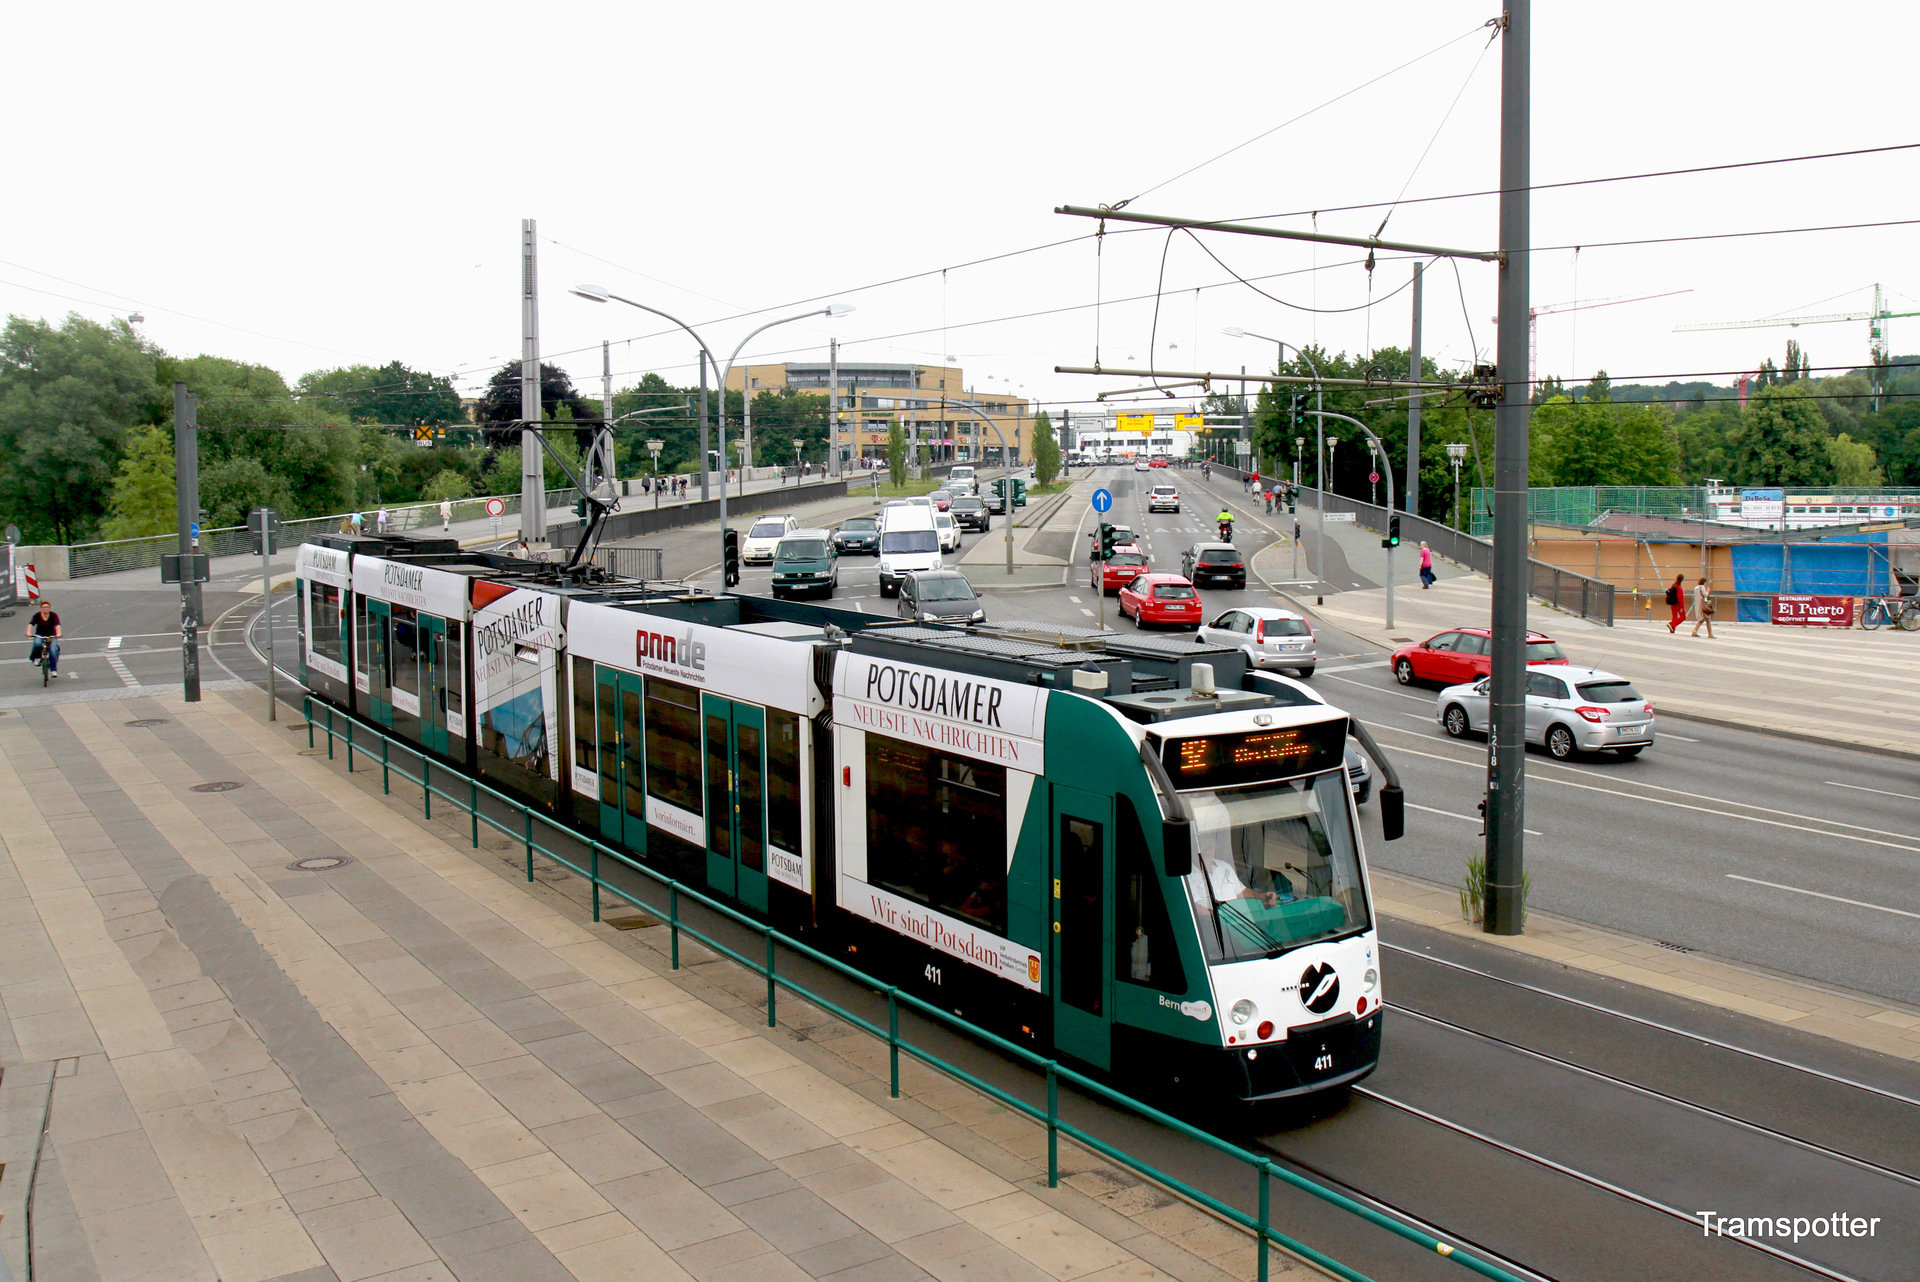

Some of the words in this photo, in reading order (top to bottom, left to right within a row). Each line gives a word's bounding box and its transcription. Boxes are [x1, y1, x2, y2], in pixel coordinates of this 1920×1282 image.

[384, 564, 424, 591] POTSDAMER
[1778, 602, 1793, 616] El
[1798, 603, 1845, 616] Puerto
[477, 596, 543, 660] POTSDAMER
[474, 655, 503, 682] NEUESTE
[663, 664, 680, 678] Neueste
[680, 669, 706, 683] Nachrichten
[867, 663, 1002, 729] POTSDAMER
[853, 703, 908, 734] NEUESTE
[913, 717, 1019, 761] NACHRICHTEN
[871, 894, 898, 925] Wir
[900, 909, 929, 939] sind
[934, 919, 1003, 971] Potsdam.
[924, 963, 942, 986] 411
[1159, 994, 1180, 1011] Bern
[1314, 1053, 1332, 1071] 411
